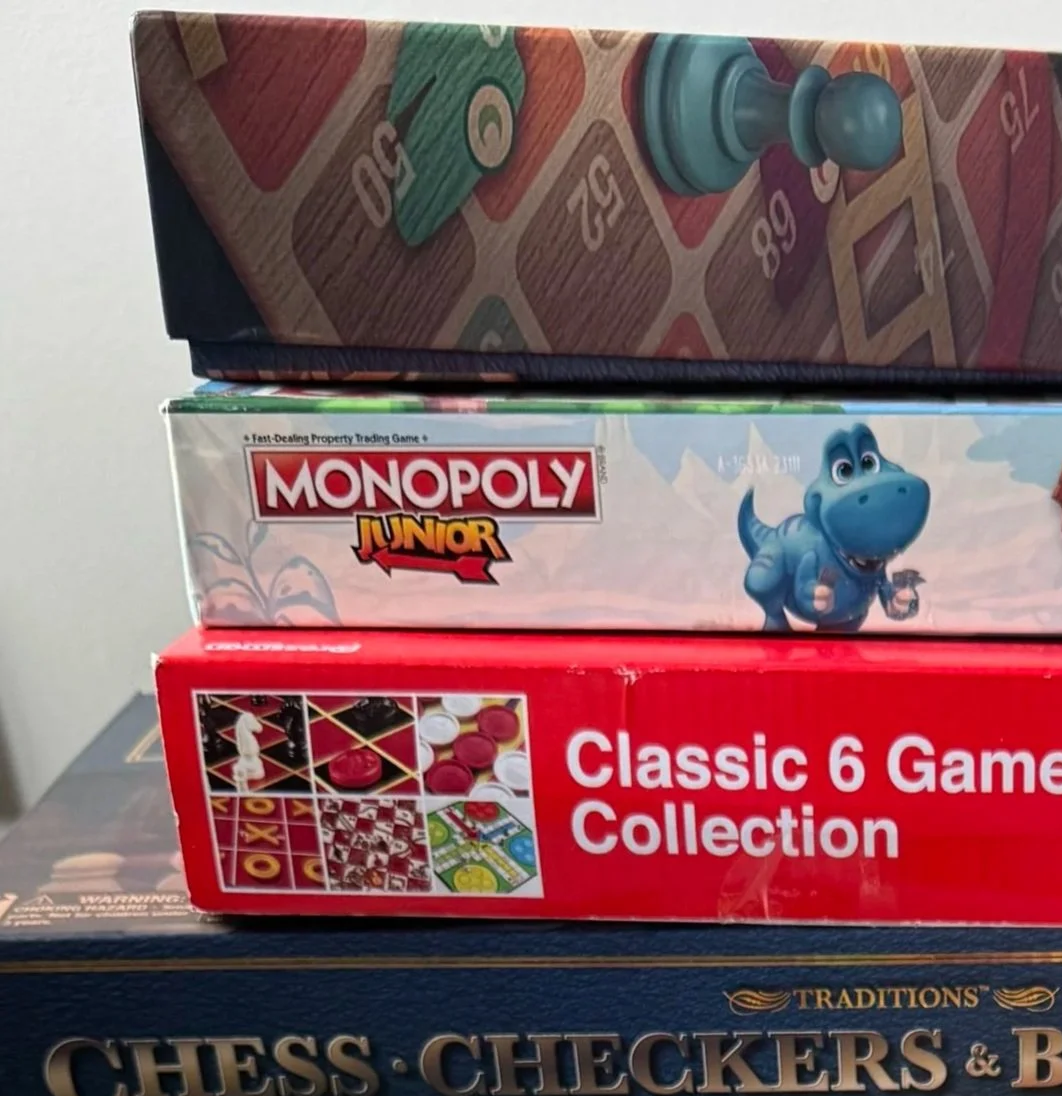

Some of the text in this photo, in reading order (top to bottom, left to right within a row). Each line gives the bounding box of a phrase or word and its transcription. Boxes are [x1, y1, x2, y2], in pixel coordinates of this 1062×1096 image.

[1000, 73, 1041, 153] 75
[351, 119, 416, 229] 50
[565, 153, 625, 252] 52
[750, 188, 797, 281] 68
[252, 433, 420, 446] Fast-Dealing Property Trading Game
[263, 456, 589, 511] MONOPOLY
[356, 514, 504, 561] JUNIOR
[566, 729, 808, 790] Classic
[828, 734, 866, 793] 6
[571, 798, 900, 859] Collection
[14, 905, 82, 913] CHOKING
[85, 904, 148, 912] HAZARD
[80, 893, 186, 905] WARNING:
[416, 1027, 948, 1096] CHECKERS
[964, 1042, 1002, 1078] &
